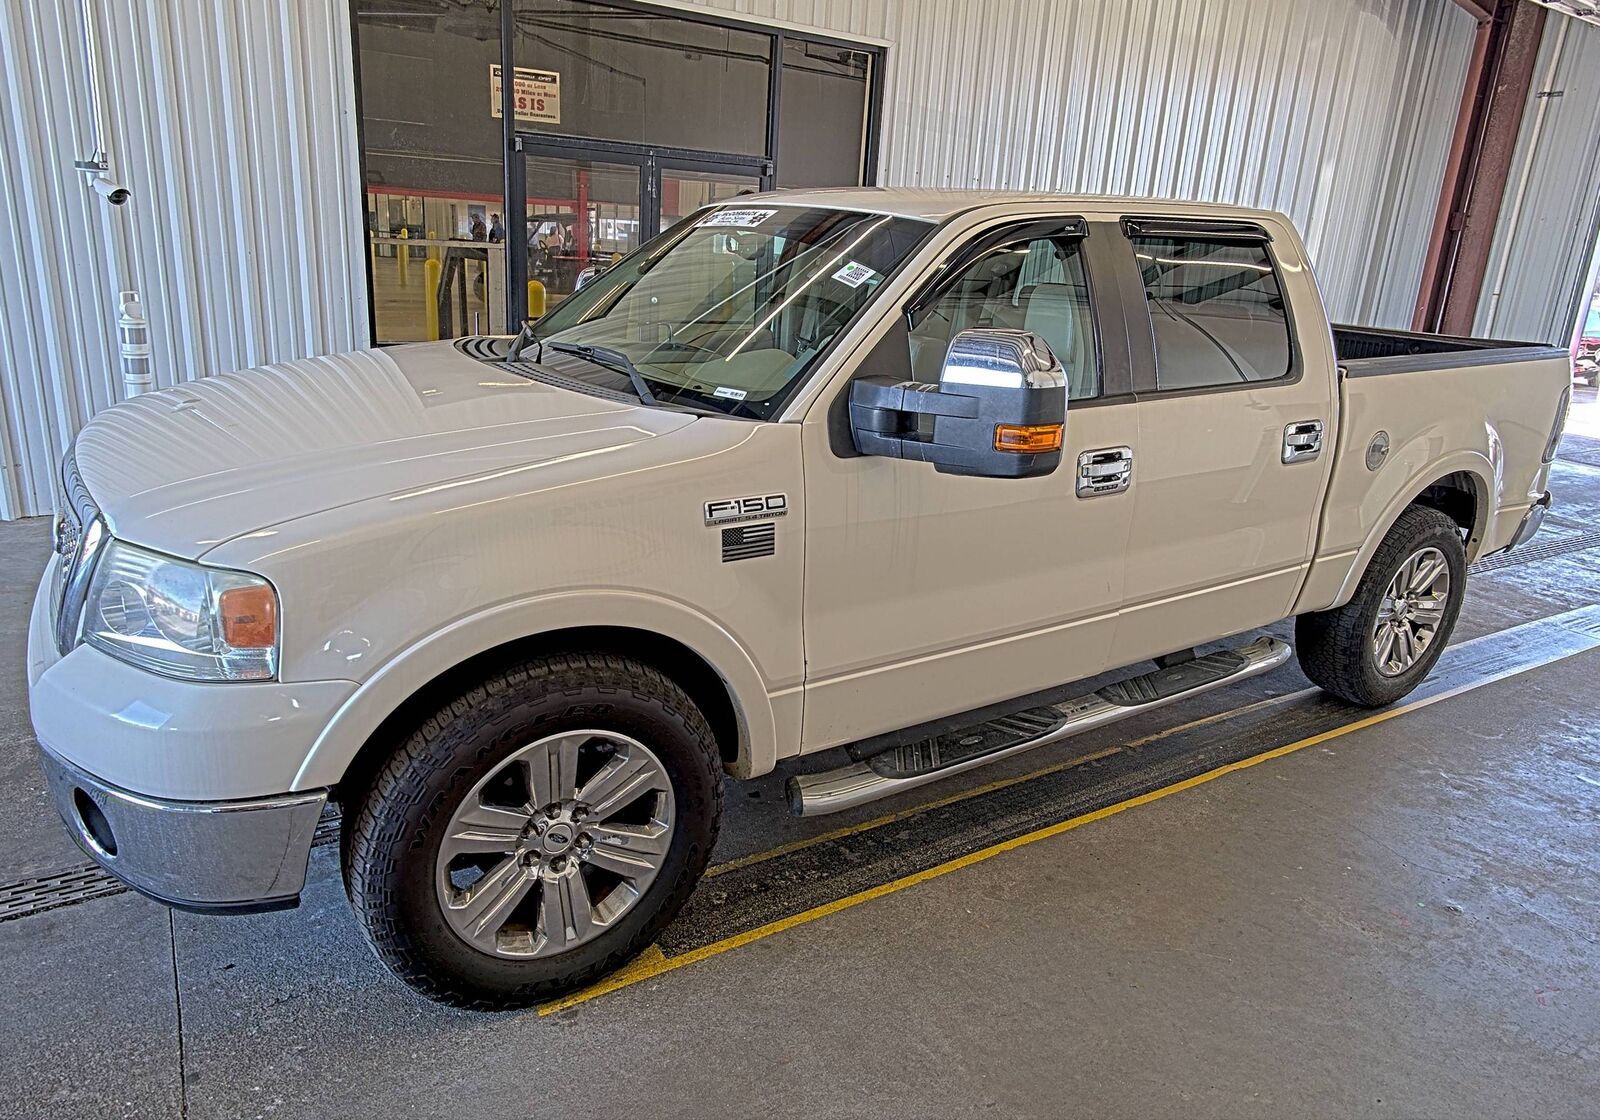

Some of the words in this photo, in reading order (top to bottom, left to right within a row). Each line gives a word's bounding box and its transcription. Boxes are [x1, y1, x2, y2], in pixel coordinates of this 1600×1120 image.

[521, 89, 536, 97] Miles
[544, 91, 557, 99] More
[530, 98, 545, 112] IS
[707, 494, 787, 518] F-150
[714, 517, 742, 525] LARIAT
[759, 511, 787, 519] TRITON
[408, 703, 616, 850] WRANGLER
[513, 842, 698, 996] GOODYEAR
